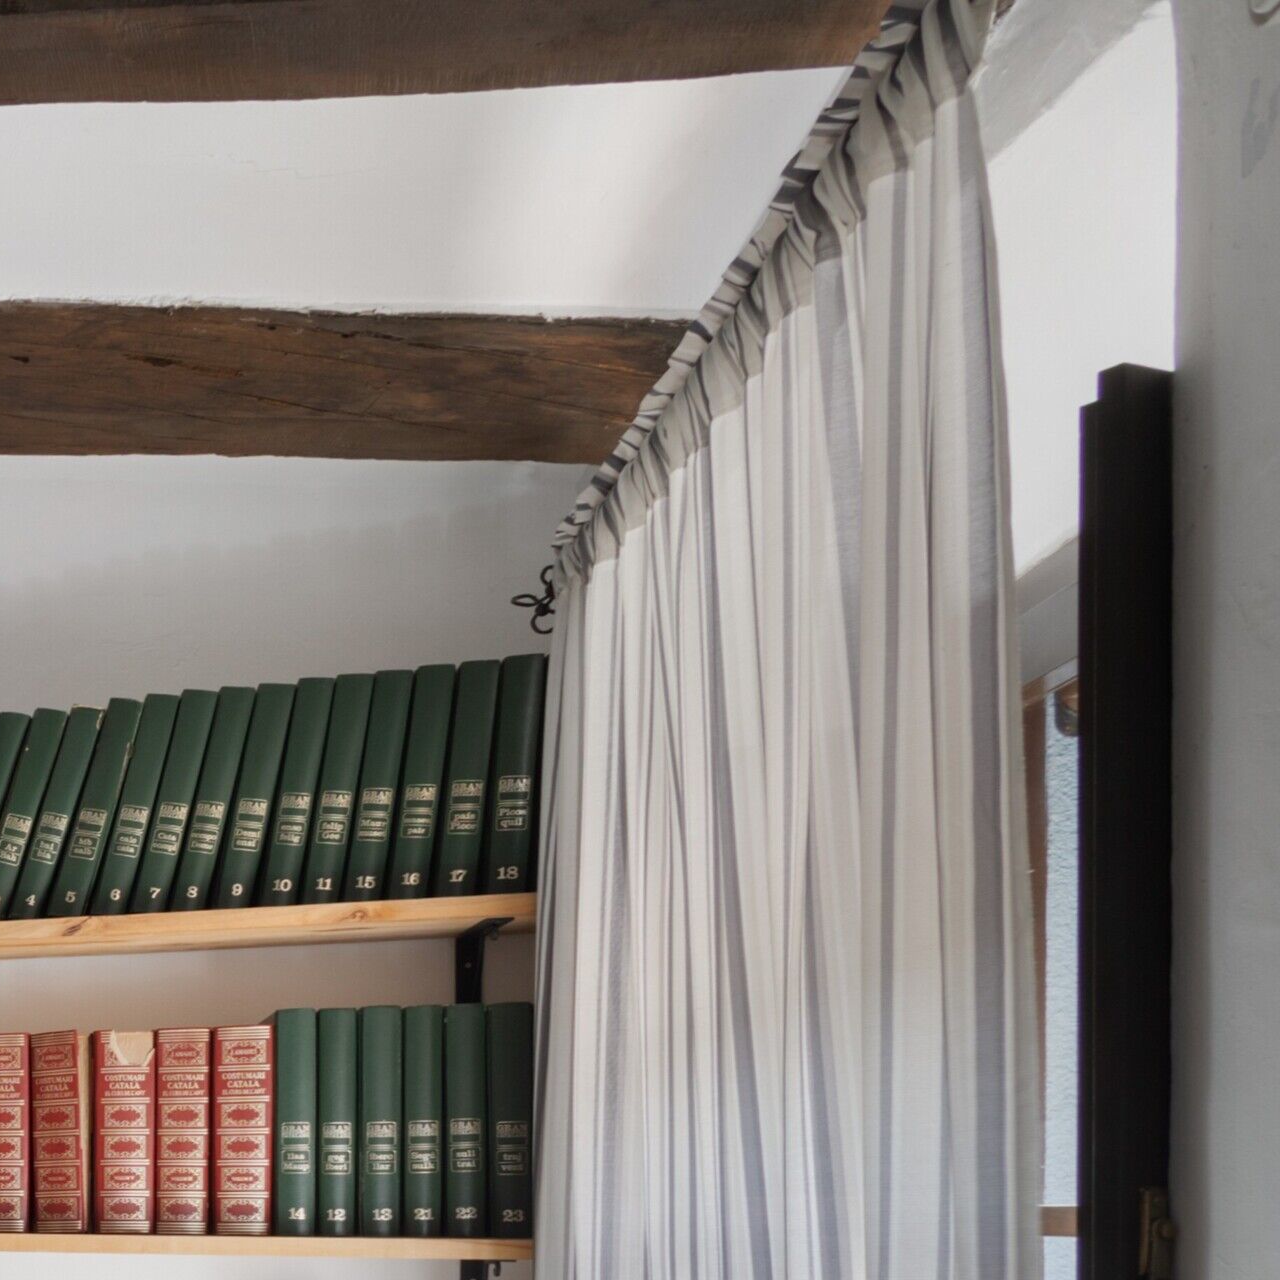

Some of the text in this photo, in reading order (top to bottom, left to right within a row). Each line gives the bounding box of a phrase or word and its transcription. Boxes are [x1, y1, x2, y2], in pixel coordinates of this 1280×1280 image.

[401, 872, 420, 886] 16
[449, 869, 467, 882] 17
[496, 866, 519, 880] 18
[272, 879, 293, 892] 10
[315, 878, 333, 891] 11
[355, 876, 376, 889] 15
[110, 888, 121, 901] 6
[150, 887, 161, 899] 7
[186, 885, 198, 898] 8
[231, 883, 243, 896] 9
[25, 894, 37, 906] 4
[65, 891, 77, 903] 5
[36, 1075, 73, 1085] COSTUMARI
[104, 1074, 146, 1082] COSTUMARI
[222, 1071, 266, 1080] COSTUMARI
[288, 1207, 306, 1220] 14
[326, 1208, 346, 1221] 12
[372, 1207, 393, 1221] 13
[414, 1207, 434, 1220] 21
[455, 1206, 477, 1220] 22
[502, 1209, 524, 1222] 23
